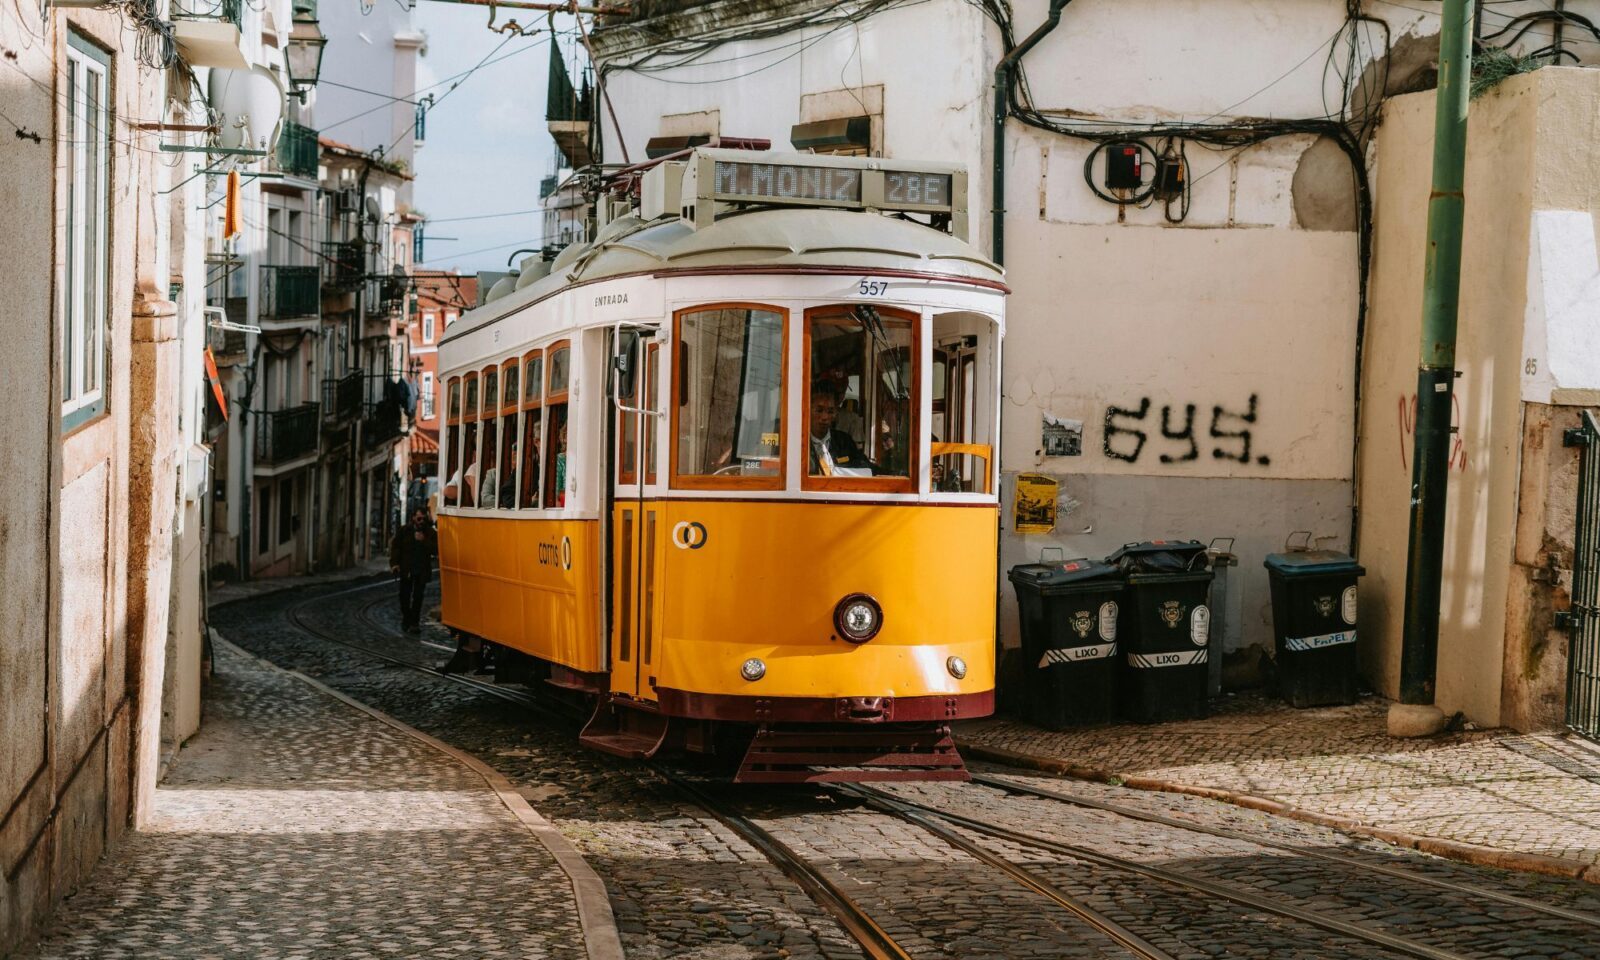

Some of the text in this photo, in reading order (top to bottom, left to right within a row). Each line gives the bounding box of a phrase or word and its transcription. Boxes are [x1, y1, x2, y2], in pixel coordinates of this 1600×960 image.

[715, 160, 857, 201] M.MONIZ
[889, 175, 941, 204] 28E
[859, 280, 889, 297] 557
[594, 293, 629, 308] ENTRADA
[1525, 357, 1538, 376] 85
[538, 534, 559, 568] carris
[1075, 647, 1099, 659] LIXO
[1156, 654, 1180, 665] LIXO
